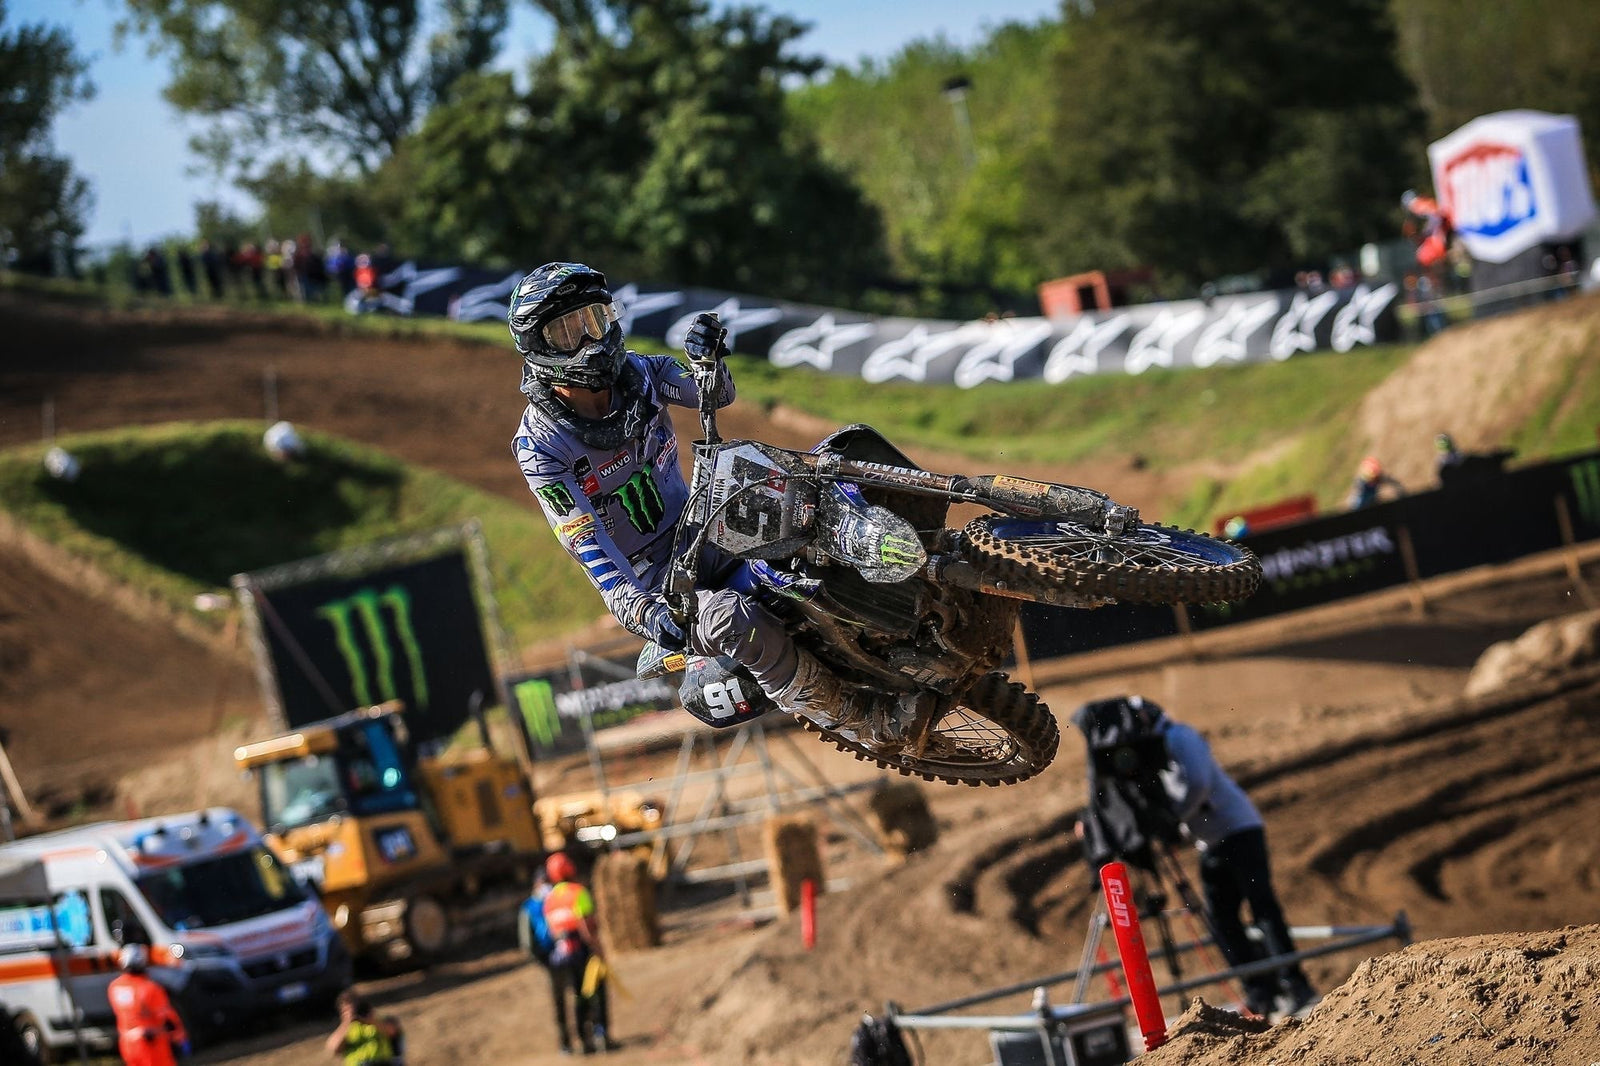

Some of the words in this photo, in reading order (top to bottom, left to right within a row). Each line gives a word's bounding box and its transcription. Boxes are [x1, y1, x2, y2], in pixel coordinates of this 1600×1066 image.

[601, 455, 631, 477] WILVO
[866, 526, 882, 565] YAMAHA
[702, 678, 747, 719] 91
[1108, 878, 1130, 927] UFO
